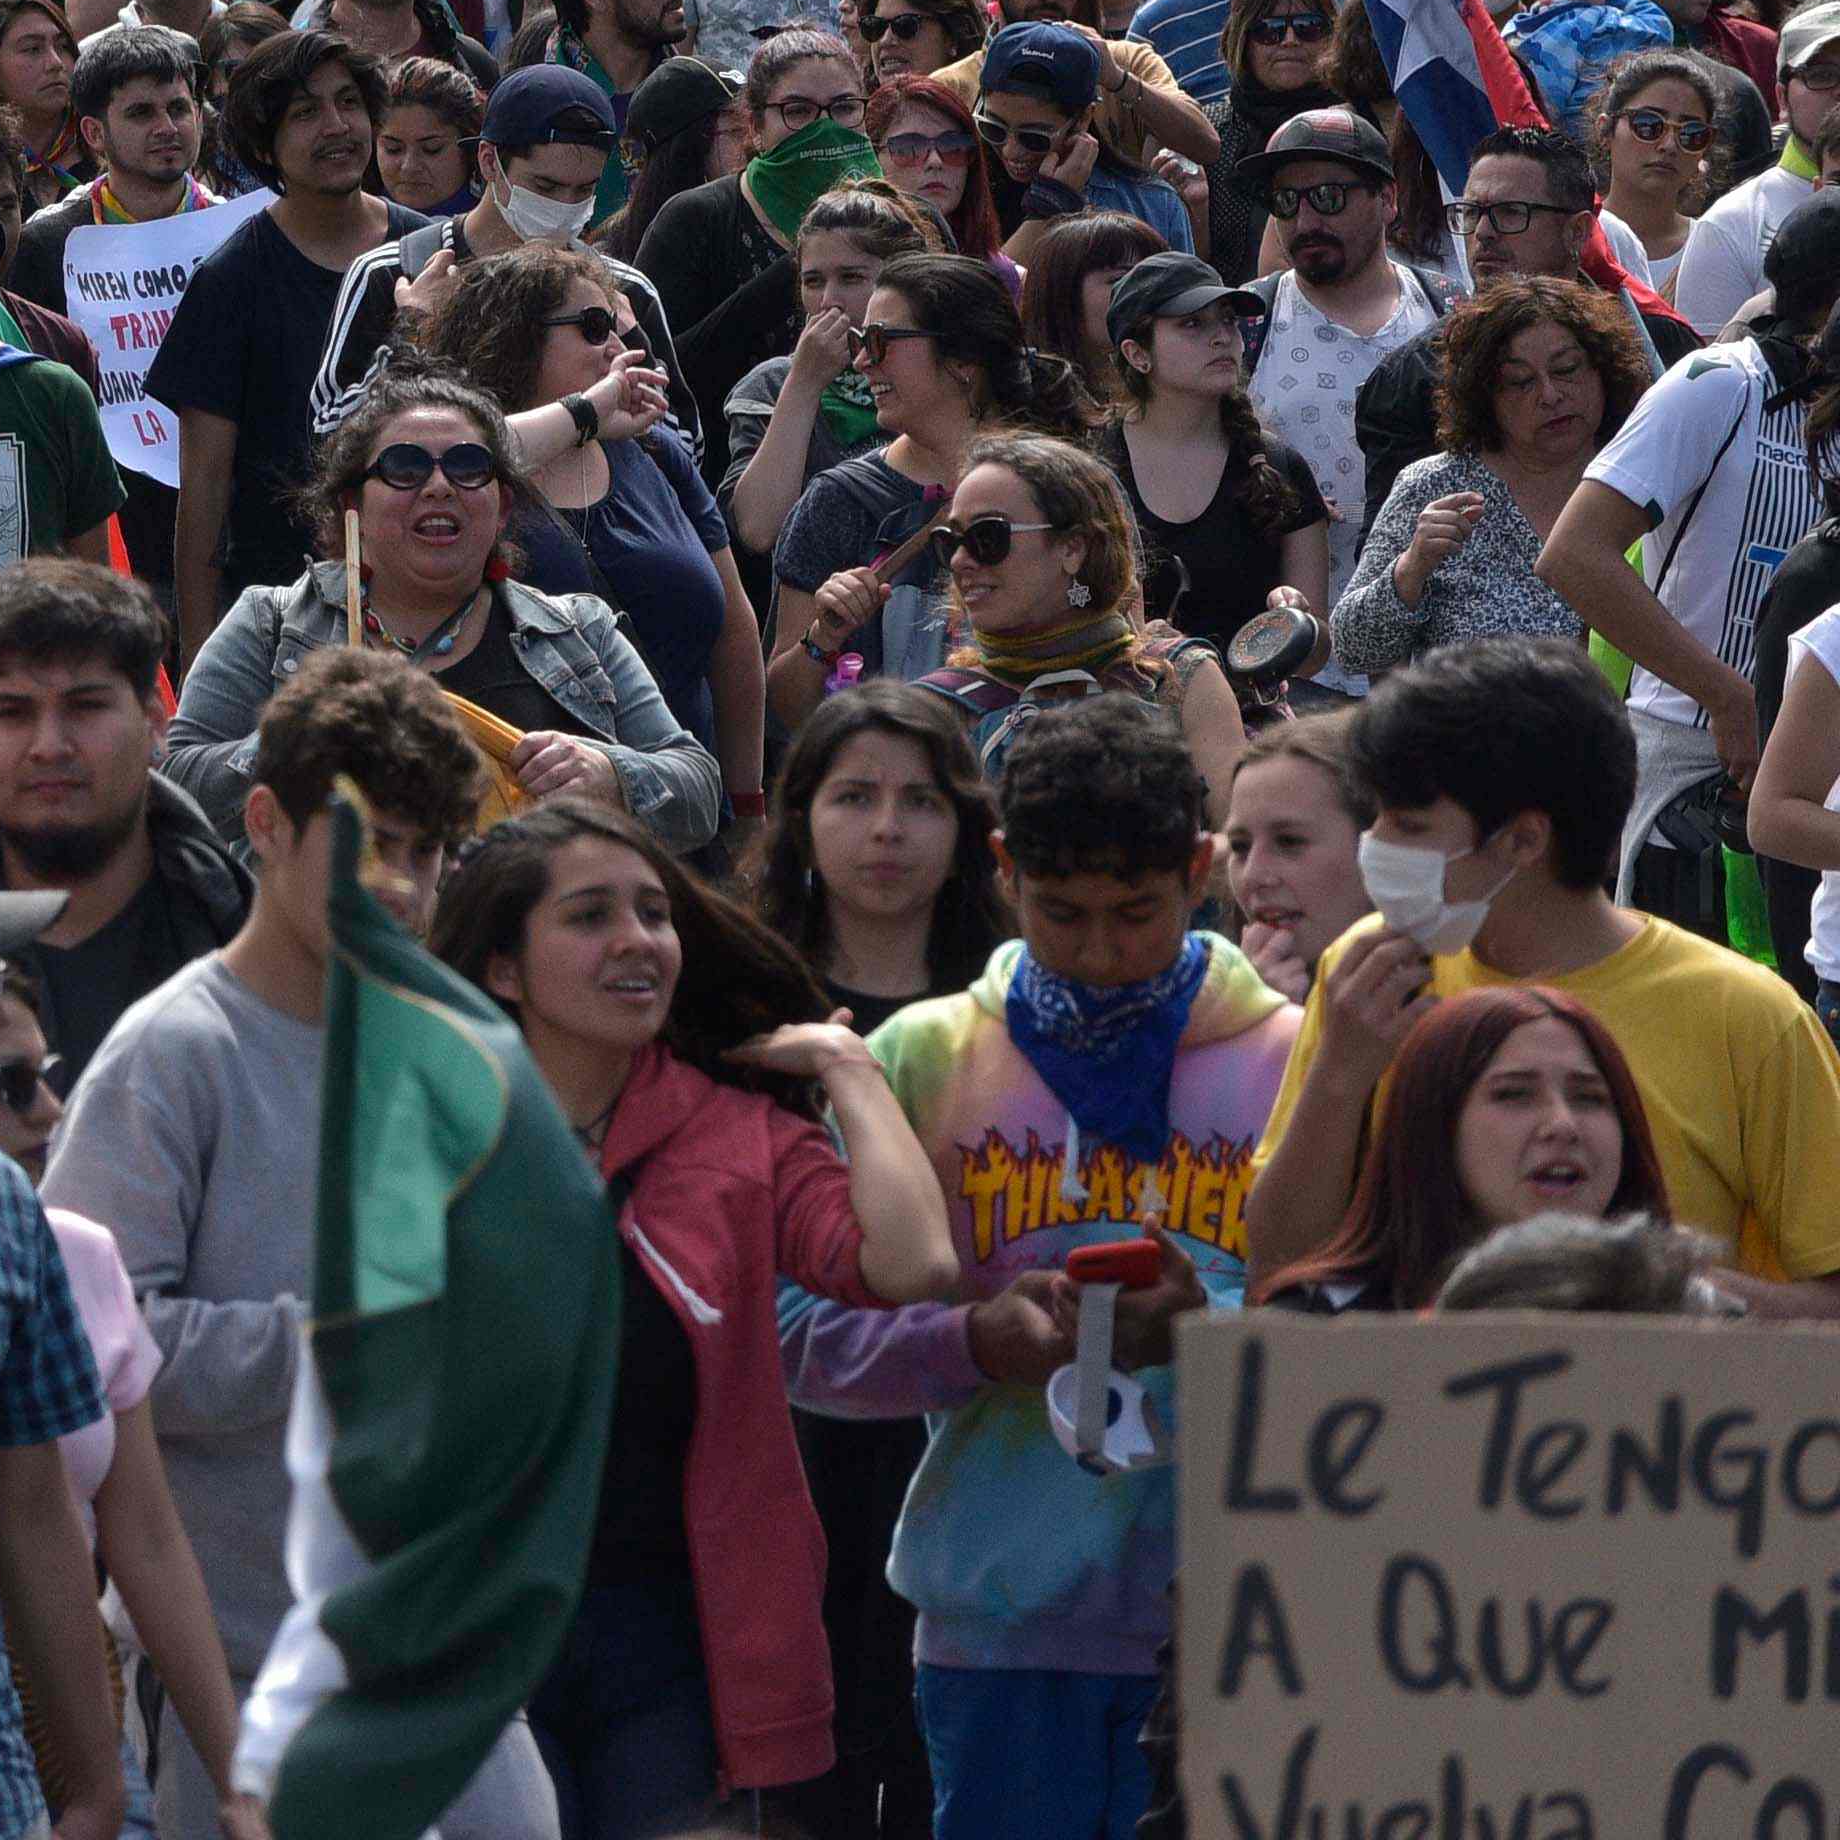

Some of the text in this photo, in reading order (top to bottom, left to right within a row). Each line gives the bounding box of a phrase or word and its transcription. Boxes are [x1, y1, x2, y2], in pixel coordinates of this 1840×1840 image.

[134, 266, 189, 301] COMO
[132, 410, 169, 448] LA
[1223, 1336, 1386, 1516] Le
[1217, 1563, 1304, 1699] A
[1374, 1555, 1616, 1698] Que
